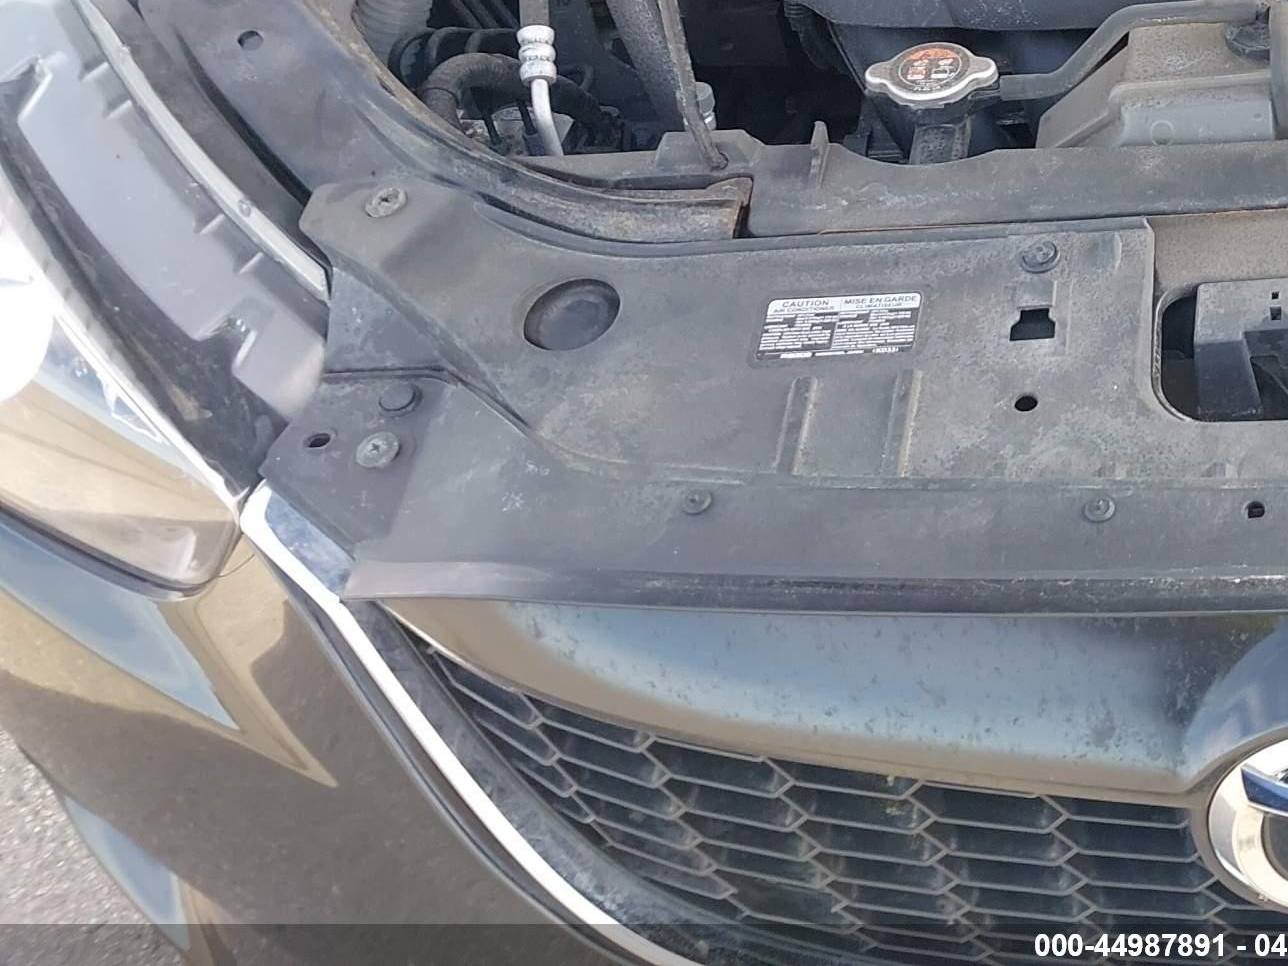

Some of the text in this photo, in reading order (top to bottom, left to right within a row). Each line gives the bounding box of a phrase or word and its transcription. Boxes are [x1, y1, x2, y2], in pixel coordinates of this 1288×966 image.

[782, 299, 830, 308] CAUTION
[844, 295, 917, 305] MISE EN GARDE
